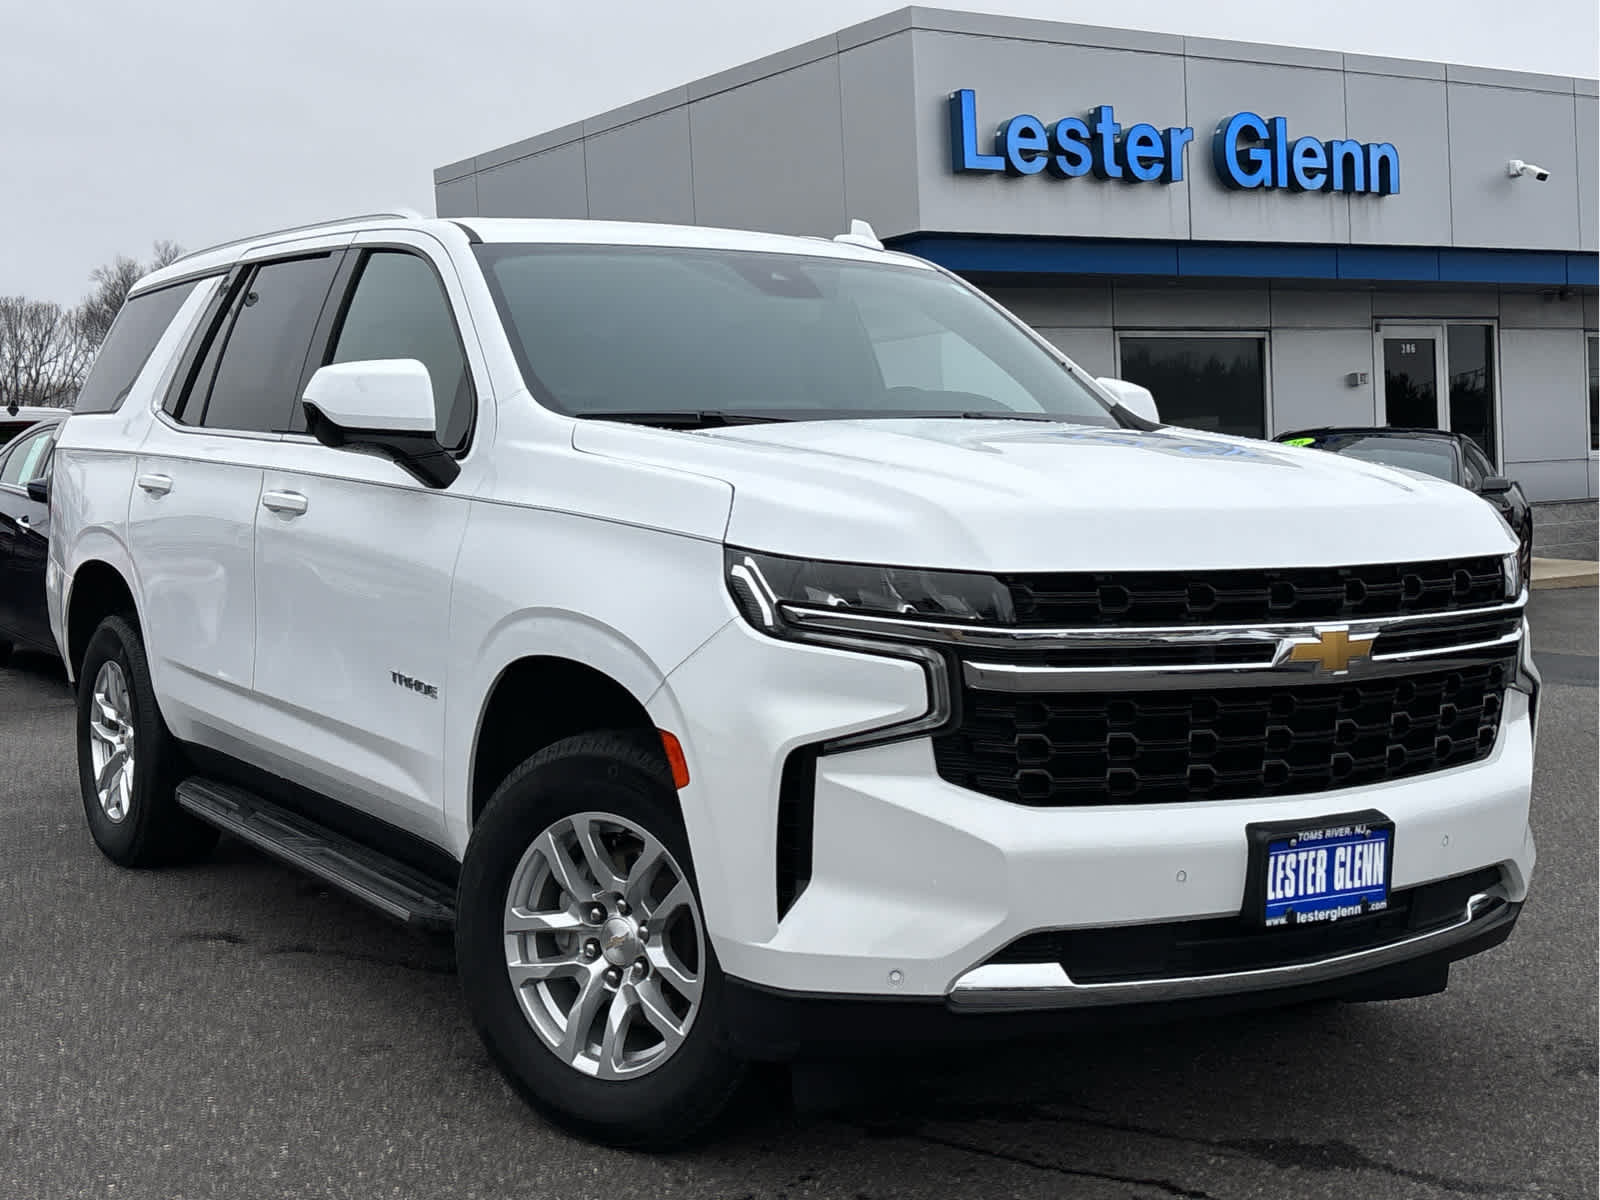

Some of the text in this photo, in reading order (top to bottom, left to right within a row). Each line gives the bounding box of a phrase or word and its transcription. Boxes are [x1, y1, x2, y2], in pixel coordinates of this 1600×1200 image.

[950, 88, 1400, 195] Lester Glenn
[390, 671, 438, 700] TAHOE
[1298, 830, 1323, 842] TOMS
[1267, 841, 1385, 901] LESTER GLENN
[1296, 904, 1361, 924] lesterglenn
